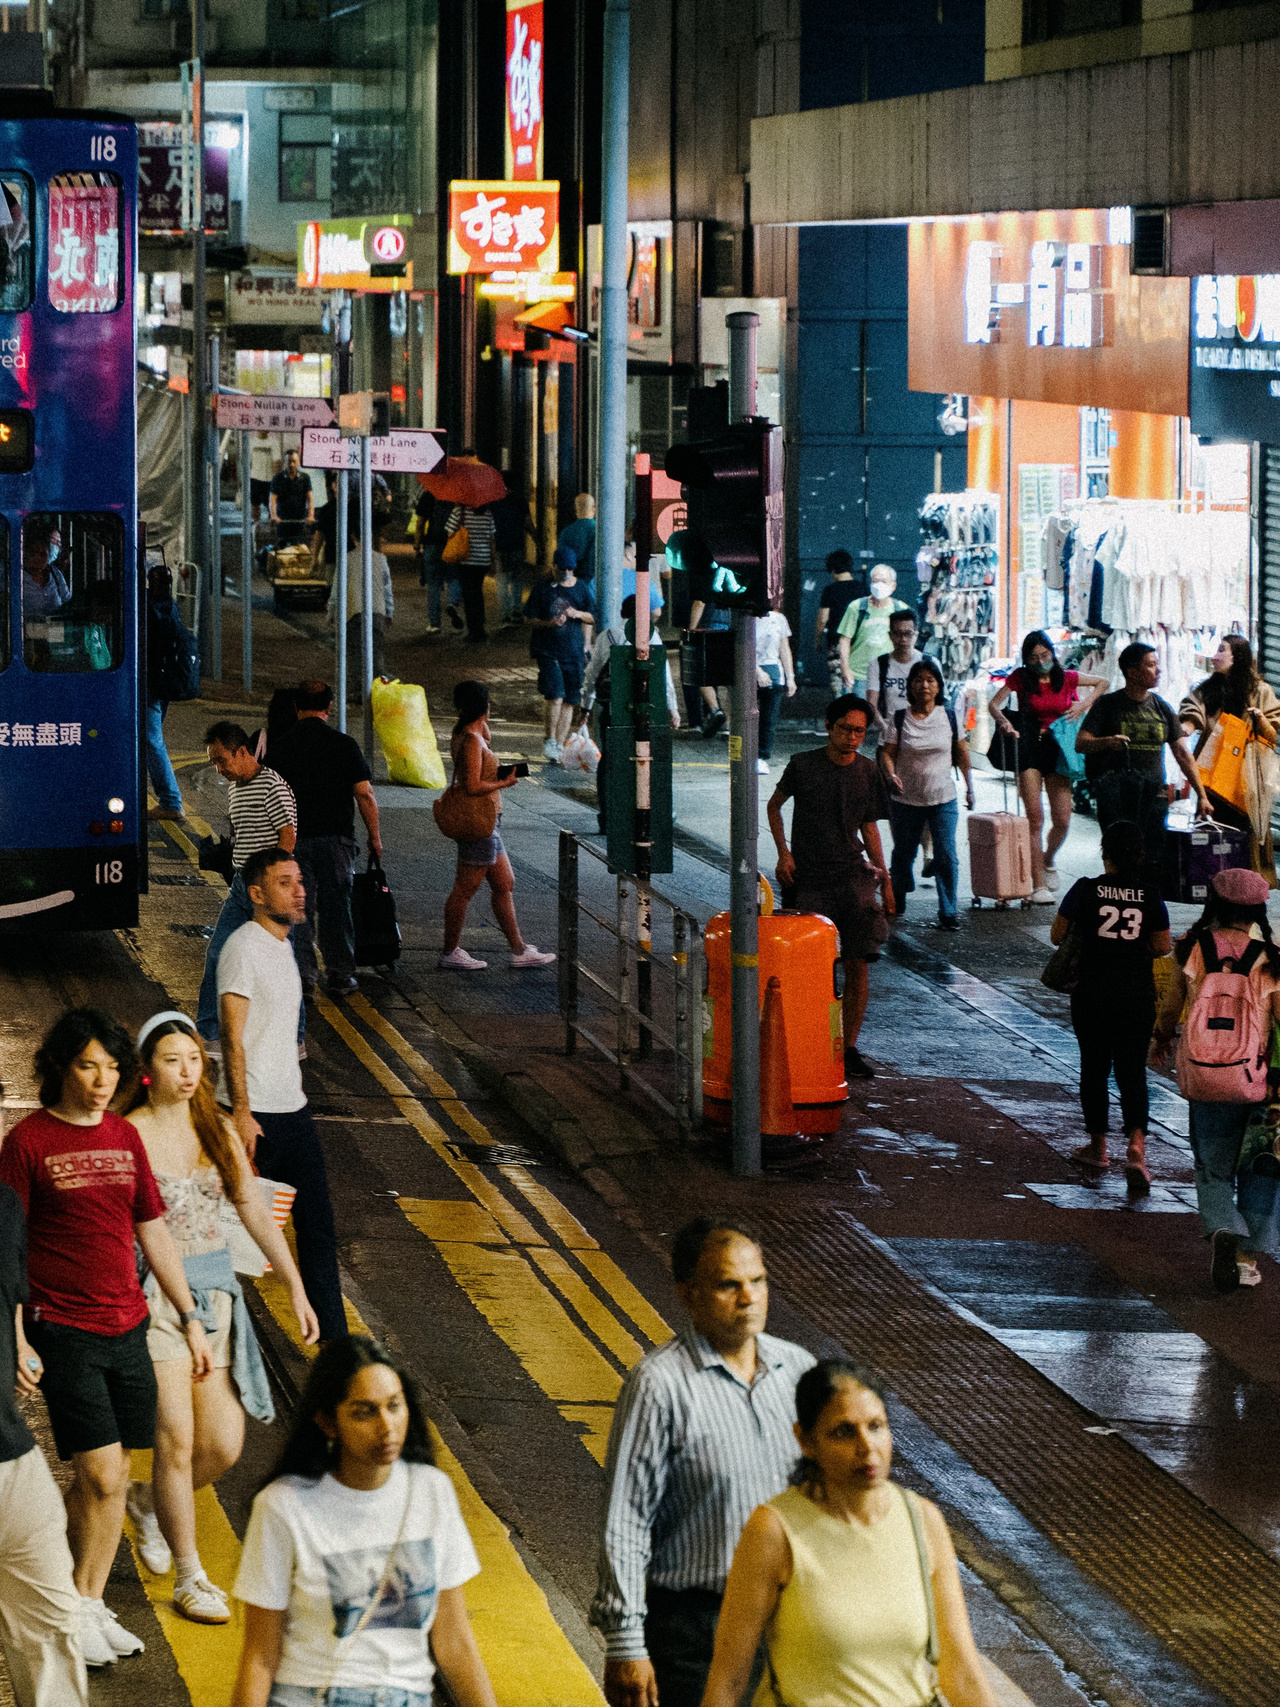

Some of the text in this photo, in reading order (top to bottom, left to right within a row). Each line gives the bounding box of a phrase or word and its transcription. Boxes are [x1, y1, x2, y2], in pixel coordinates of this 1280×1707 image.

[90, 135, 118, 162] 118
[459, 192, 547, 252] すき家
[220, 398, 316, 412] Stone Nullah Lane
[309, 433, 343, 446] Stone
[390, 437, 418, 449] Lane
[94, 860, 124, 886] 118
[1096, 885, 1145, 903] SHANELE
[1097, 905, 1144, 940] 23
[50, 1155, 116, 1175] adidas
